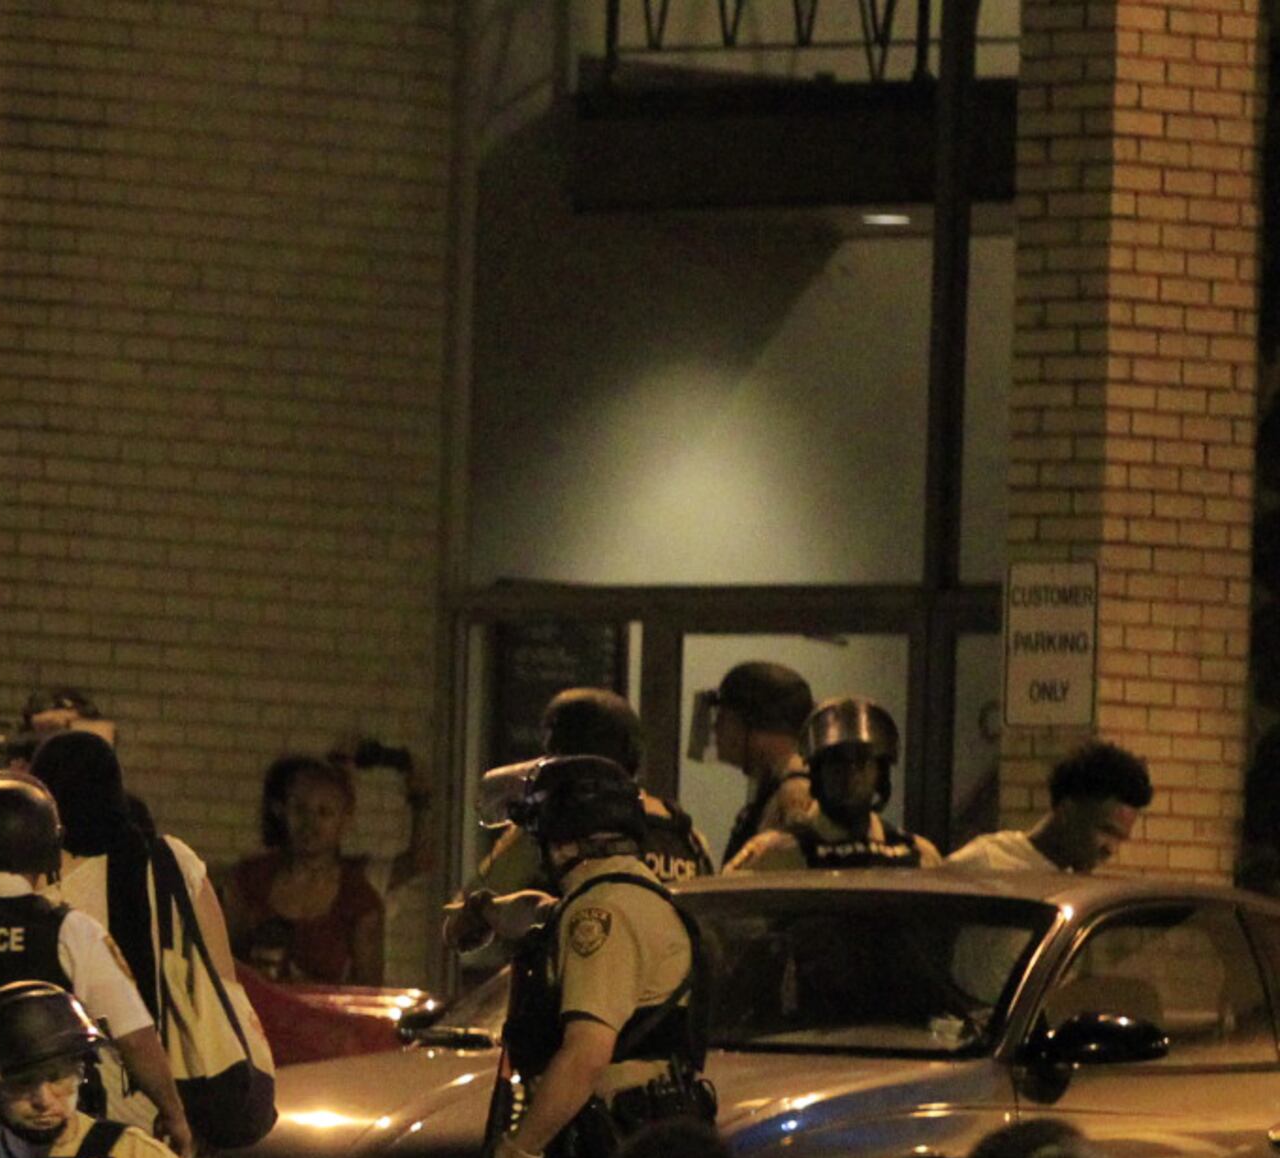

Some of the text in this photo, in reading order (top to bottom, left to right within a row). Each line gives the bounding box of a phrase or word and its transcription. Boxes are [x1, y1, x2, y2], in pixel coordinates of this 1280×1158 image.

[1010, 585, 1096, 608] CUSTOMER
[1014, 631, 1089, 653] PARKING
[1030, 680, 1070, 703] ONLY
[645, 852, 697, 882] OLICE
